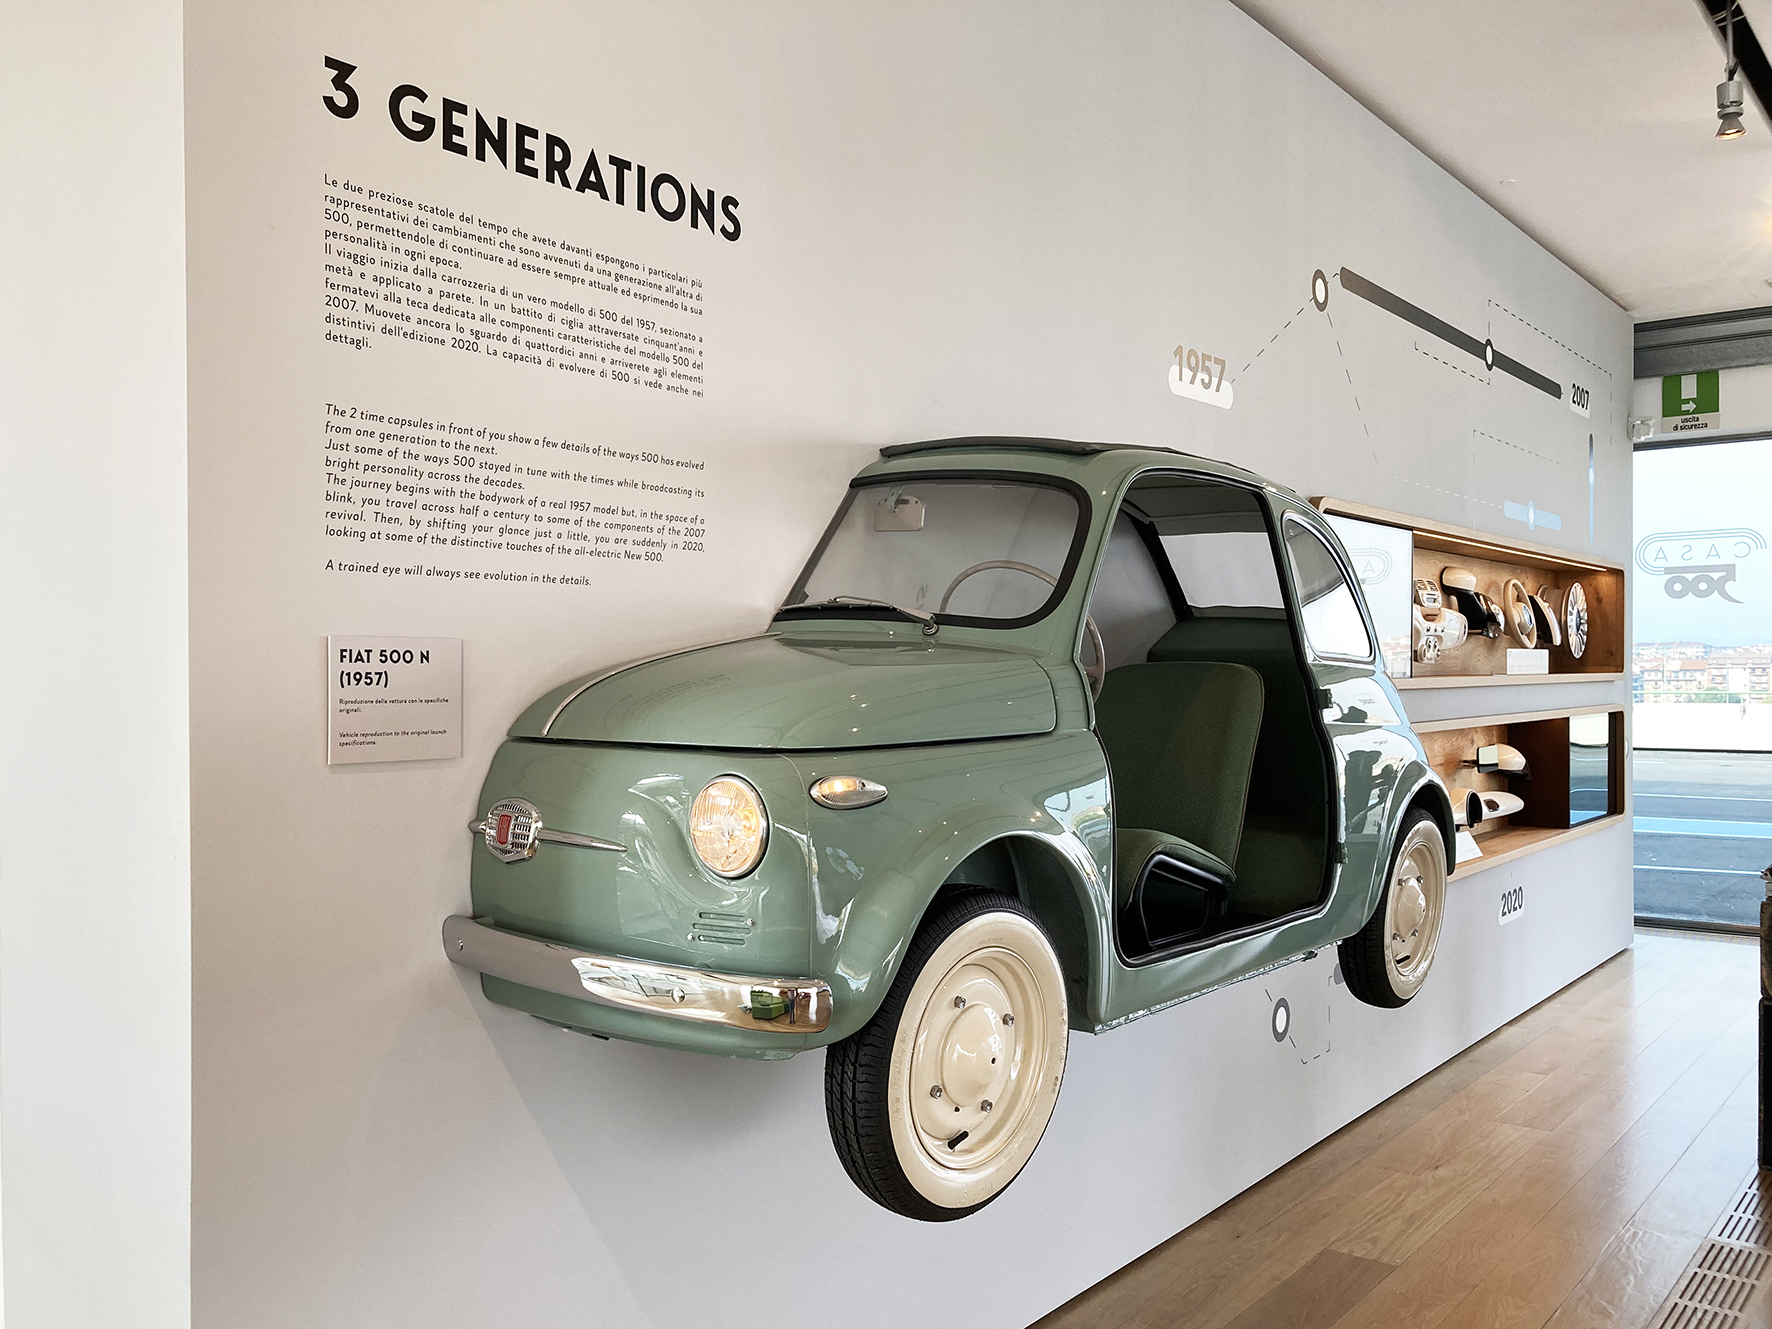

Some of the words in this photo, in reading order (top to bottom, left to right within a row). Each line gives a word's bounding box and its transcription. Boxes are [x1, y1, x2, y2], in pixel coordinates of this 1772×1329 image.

[322, 55, 359, 119] 3
[388, 84, 742, 242] GENERATIONS
[324, 173, 338, 188] Le
[343, 179, 363, 195] due
[368, 189, 413, 208] preziose
[418, 203, 455, 220] scatole
[459, 212, 473, 225] del
[478, 218, 508, 235] tempo
[512, 227, 528, 240] che
[532, 235, 557, 248] avete
[560, 240, 592, 257] davanti
[595, 253, 640, 271] espongono
[643, 263, 645, 272] i
[648, 267, 688, 284] particolari
[691, 278, 702, 288] più
[324, 195, 409, 223] rappresentativi
[413, 215, 428, 229] dei
[432, 223, 496, 246] cambiamenti
[499, 239, 516, 252] che
[519, 246, 540, 258] sono
[543, 253, 581, 269] avvenuti
[583, 261, 594, 273] da
[597, 268, 612, 277] una
[614, 272, 663, 291] generazione
[665, 284, 693, 299] all'altra
[695, 292, 702, 302] di
[325, 229, 387, 251] personalità
[391, 242, 400, 254] in
[404, 249, 426, 262] ogni
[429, 255, 462, 270] epoca.
[325, 329, 372, 350] dettagli.
[1173, 344, 1226, 393] 1957
[1572, 383, 1590, 411] 2007
[325, 420, 352, 435] from
[355, 429, 376, 438] one
[379, 432, 437, 447] generation
[440, 439, 451, 449] to
[454, 440, 471, 452] the
[473, 445, 498, 455] next.
[1680, 422, 1708, 430] sicurezza
[324, 438, 350, 452] Just
[354, 445, 383, 456] some
[387, 447, 400, 460] of
[403, 449, 420, 461] the
[424, 454, 449, 467] ways
[453, 455, 475, 468] 500
[478, 461, 511, 474] stayed
[514, 464, 523, 474] in
[527, 466, 547, 477] tune
[550, 470, 570, 480] with
[573, 472, 588, 483] the
[591, 474, 614, 486] times
[617, 478, 639, 489] while
[641, 480, 692, 498] broadcasting
[695, 488, 705, 498] its
[325, 455, 360, 472] bright
[363, 464, 424, 481] personality
[427, 471, 461, 482] across
[464, 473, 480, 485] the
[483, 475, 525, 490] decades.
[325, 490, 356, 505] blink,
[361, 497, 381, 508] you
[386, 498, 417, 510] travel
[421, 503, 455, 514] across
[459, 504, 480, 518] half
[493, 511, 530, 524] century
[534, 513, 543, 522] to
[547, 516, 571, 525] some
[574, 516, 584, 528] of
[587, 518, 601, 528] the
[604, 522, 654, 533] components
[657, 525, 666, 536] of
[668, 526, 681, 536] the
[684, 527, 705, 538] 2007
[326, 472, 347, 486] The
[349, 476, 392, 494] journey
[395, 480, 430, 497] begins
[433, 486, 456, 497] with
[460, 488, 476, 500] the
[479, 490, 525, 505] bodywork
[528, 496, 538, 508] of
[549, 500, 567, 509] real
[570, 500, 591, 512] 1957
[593, 505, 619, 515] model
[621, 506, 637, 518] but,
[640, 509, 648, 518] in
[650, 510, 663, 520] the
[665, 514, 688, 524] space
[690, 515, 698, 525] of
[325, 509, 366, 522] revival.
[373, 511, 403, 526] Then,
[409, 515, 422, 530] by
[427, 517, 467, 534] shifting
[471, 524, 494, 534] your
[498, 524, 530, 537] glance
[533, 527, 552, 540] just
[567, 530, 590, 543] little,
[594, 536, 610, 545] you
[614, 537, 628, 545] are
[632, 537, 667, 551] suddenly
[671, 540, 678, 549] in
[682, 540, 705, 553] 2020,
[325, 524, 366, 542] looking
[370, 530, 382, 540] at
[385, 533, 413, 542] some
[416, 532, 428, 545] of
[431, 534, 448, 545] the
[450, 535, 503, 549] distinctive
[506, 541, 542, 553] touches
[545, 543, 555, 555] of
[557, 544, 572, 555] the
[574, 546, 621, 559] all-electric
[624, 550, 642, 560] New
[644, 550, 663, 562] 500.
[325, 559, 334, 571] A
[338, 561, 379, 573] trained
[382, 566, 401, 577] eye
[404, 565, 423, 576] will
[426, 566, 461, 581] always
[464, 571, 481, 579] see
[483, 570, 528, 582] evolution
[530, 573, 539, 582] in
[542, 573, 557, 584] the
[559, 574, 591, 586] details.
[339, 648, 373, 664] FIAT
[378, 649, 414, 665] 500
[419, 650, 430, 664] N
[339, 670, 389, 689] (1957)
[424, 697, 449, 705] specifiche
[360, 731, 393, 739] reproduction
[410, 729, 430, 738] original
[1501, 886, 1523, 917] 2020
